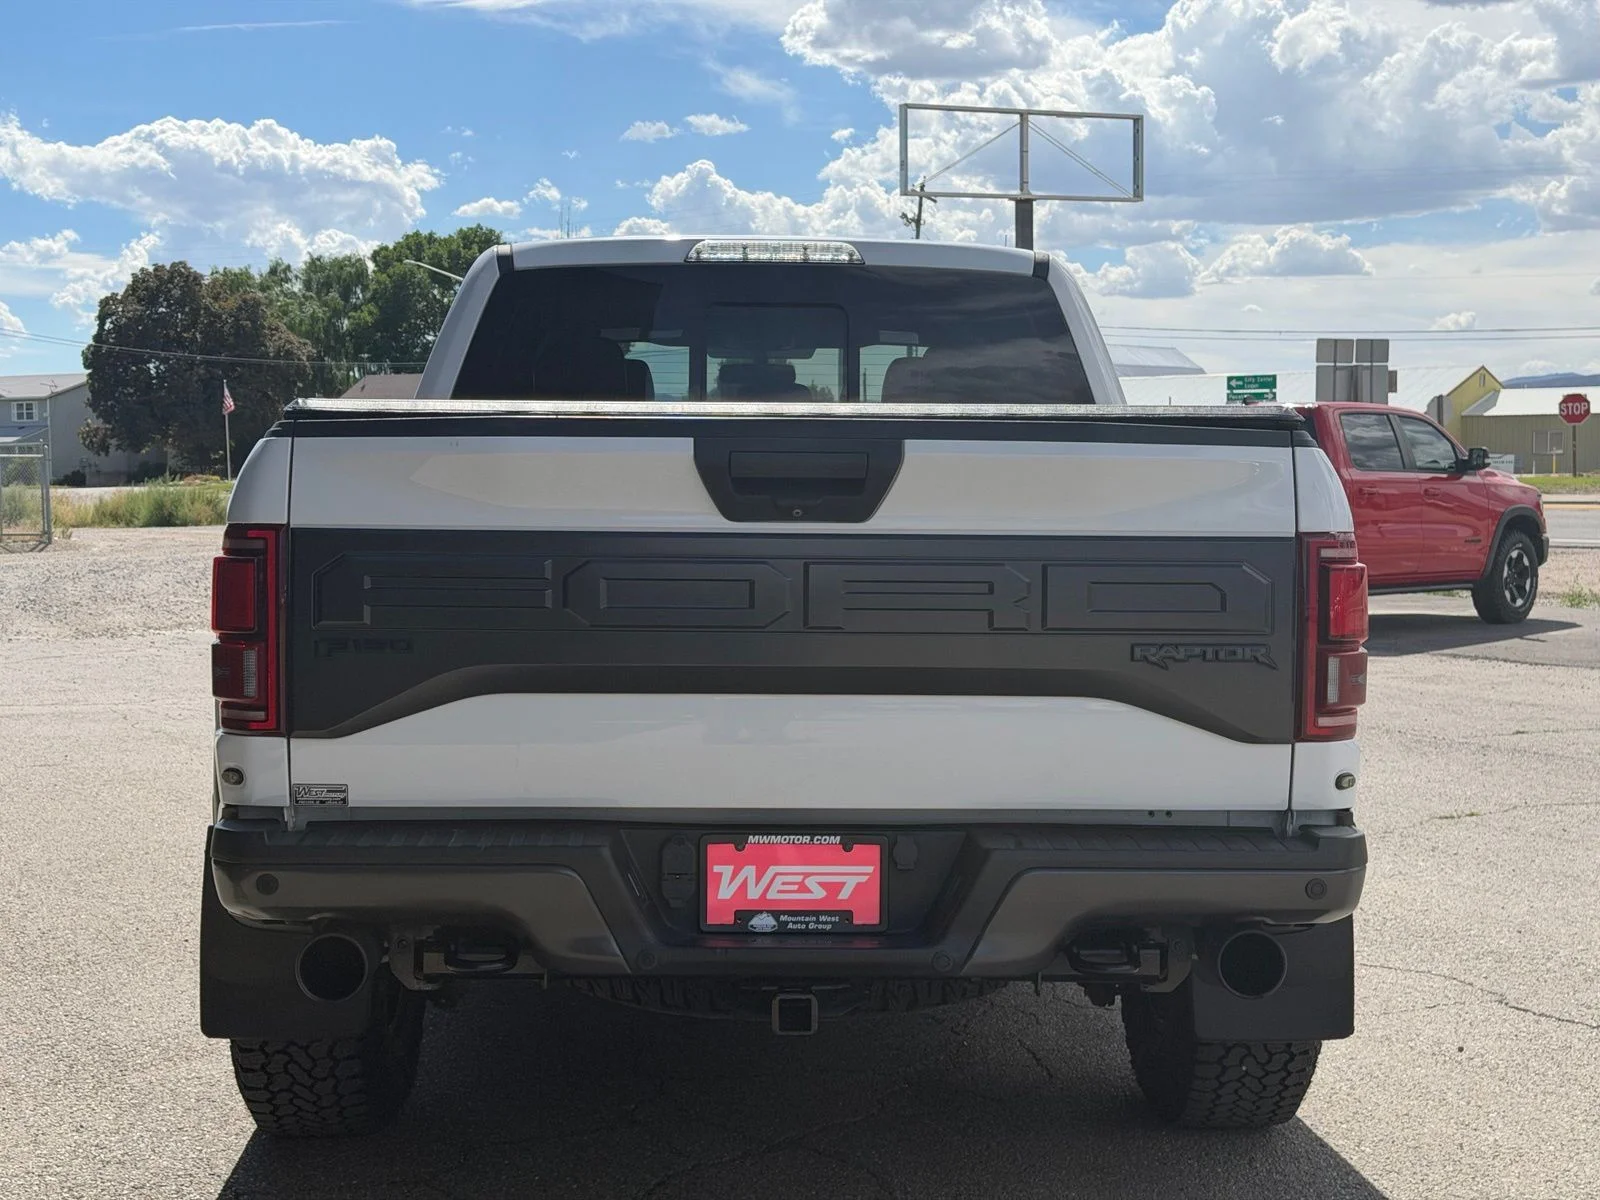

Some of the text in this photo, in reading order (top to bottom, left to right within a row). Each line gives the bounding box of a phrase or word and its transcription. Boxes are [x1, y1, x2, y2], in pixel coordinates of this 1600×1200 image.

[1560, 402, 1588, 415] STOP
[311, 551, 1274, 636] FORD
[1131, 643, 1278, 670] RAPTOR
[748, 835, 841, 845] MWMOTOR.COM
[713, 865, 875, 900] WEST
[779, 914, 840, 922] Mountain West
[808, 922, 833, 930] Group
